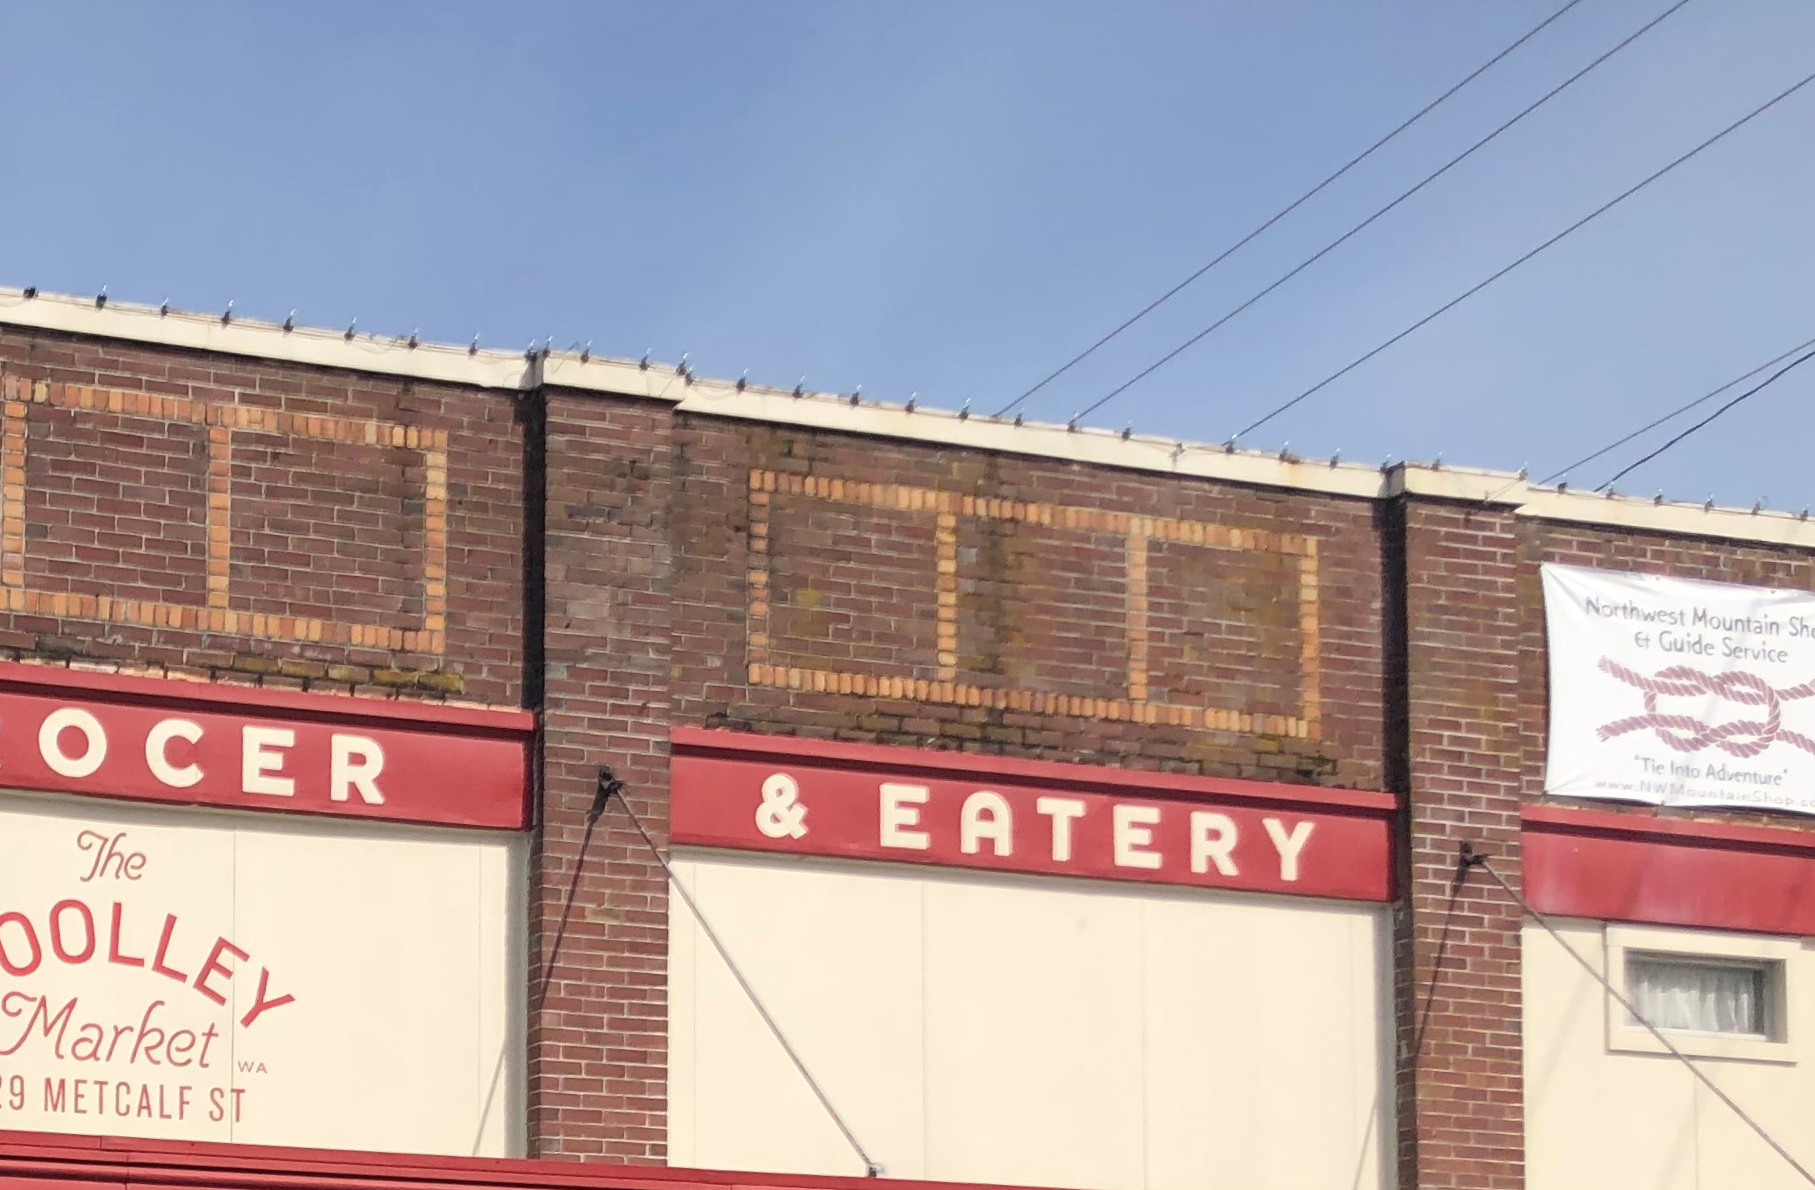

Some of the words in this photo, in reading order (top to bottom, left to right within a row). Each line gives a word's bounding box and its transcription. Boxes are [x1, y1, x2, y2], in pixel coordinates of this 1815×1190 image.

[1585, 596, 1685, 627] Northwest
[1692, 606, 1780, 637] Mountain
[1658, 630, 1715, 656] Guide
[1722, 636, 1788, 663] Service
[1670, 760, 1700, 779] Into
[755, 773, 808, 839] &
[879, 782, 1314, 881] EATERY
[76, 830, 147, 882] The
[238, 1060, 268, 1074] WA
[43, 1077, 192, 1121] METCALF
[209, 1088, 246, 1123] ST
